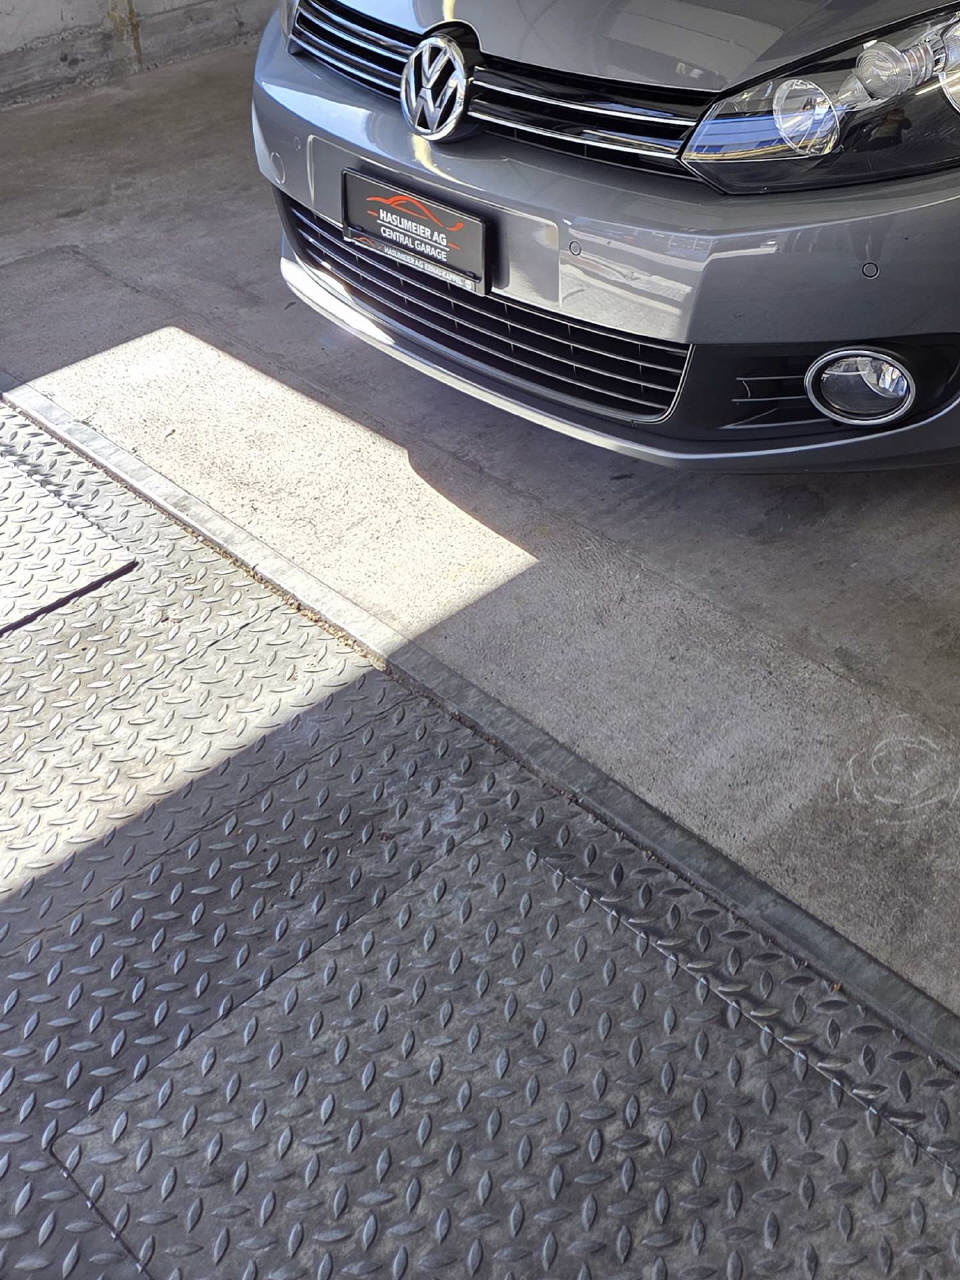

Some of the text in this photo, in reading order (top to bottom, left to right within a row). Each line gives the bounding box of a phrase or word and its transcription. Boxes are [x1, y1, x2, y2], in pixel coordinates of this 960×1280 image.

[380, 226, 448, 262] CENTRAL GARAGE
[432, 231, 447, 246] AG
